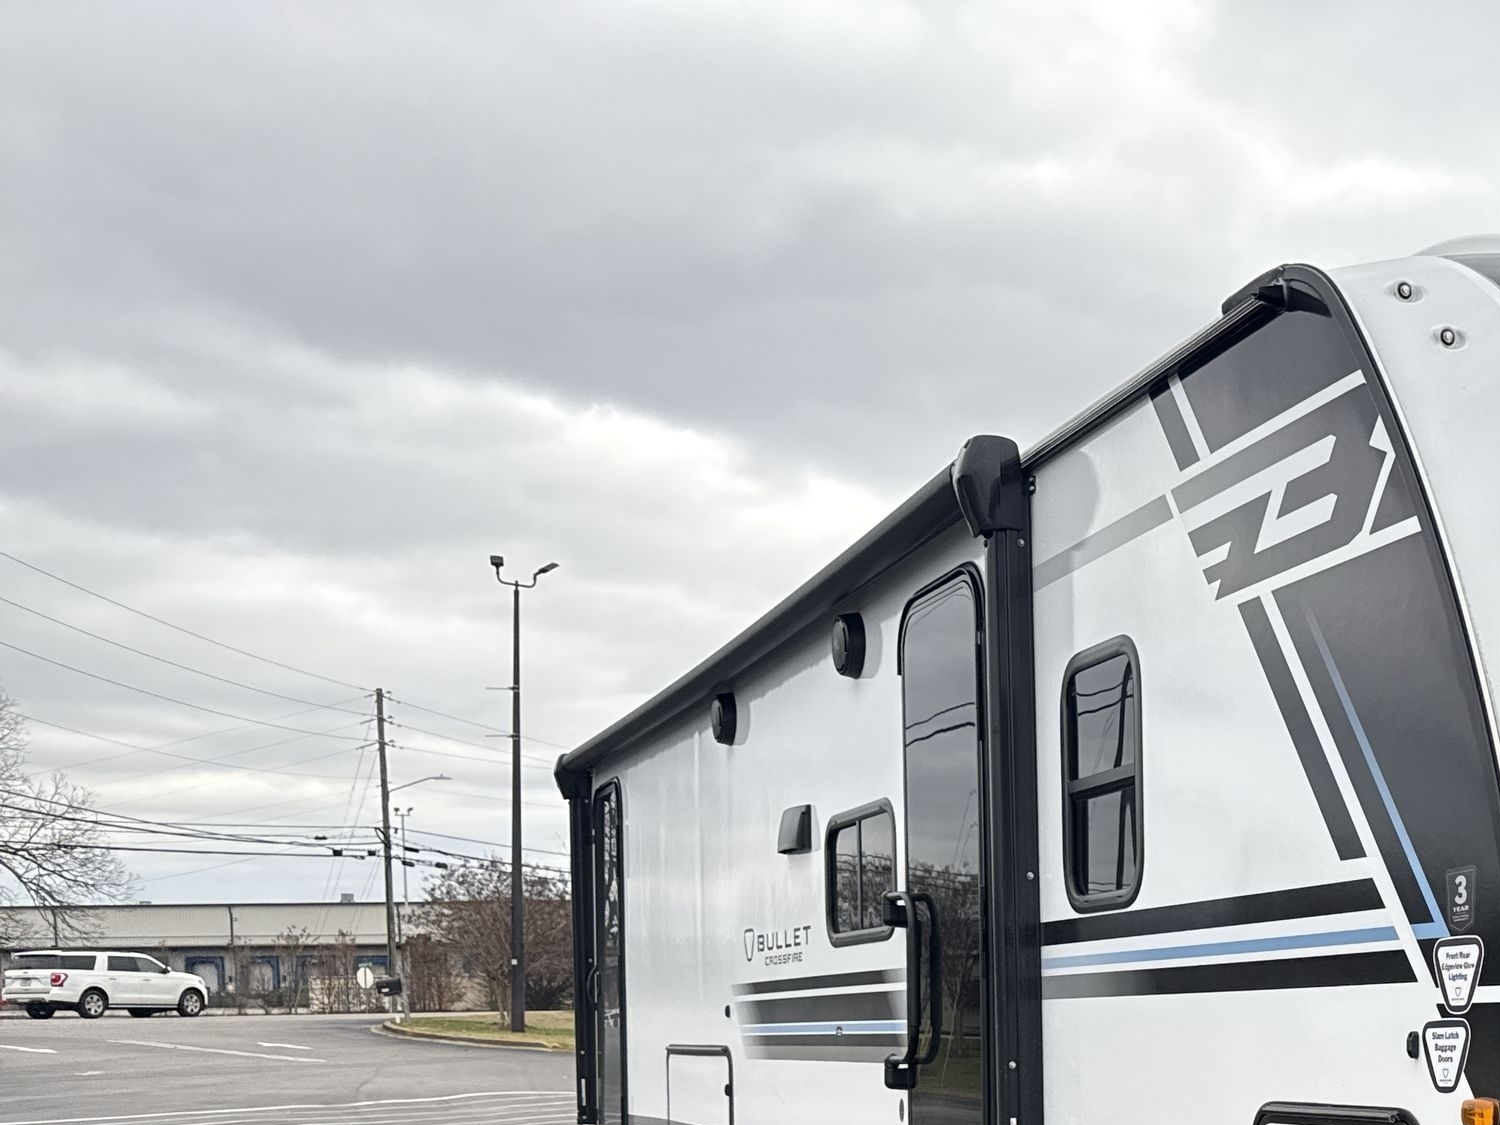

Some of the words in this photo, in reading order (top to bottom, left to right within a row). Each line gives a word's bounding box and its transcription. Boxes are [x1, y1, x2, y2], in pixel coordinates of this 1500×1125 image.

[1454, 874, 1467, 905] 3
[757, 925, 811, 952] BULLET
[764, 951, 803, 966] CROSSFIRE
[1448, 972, 1468, 982] Lighting
[1431, 1031, 1444, 1040] Slam
[1445, 1031, 1459, 1040] Latch
[1434, 1043, 1457, 1053] Baggage
[1437, 1054, 1453, 1063] Doors
